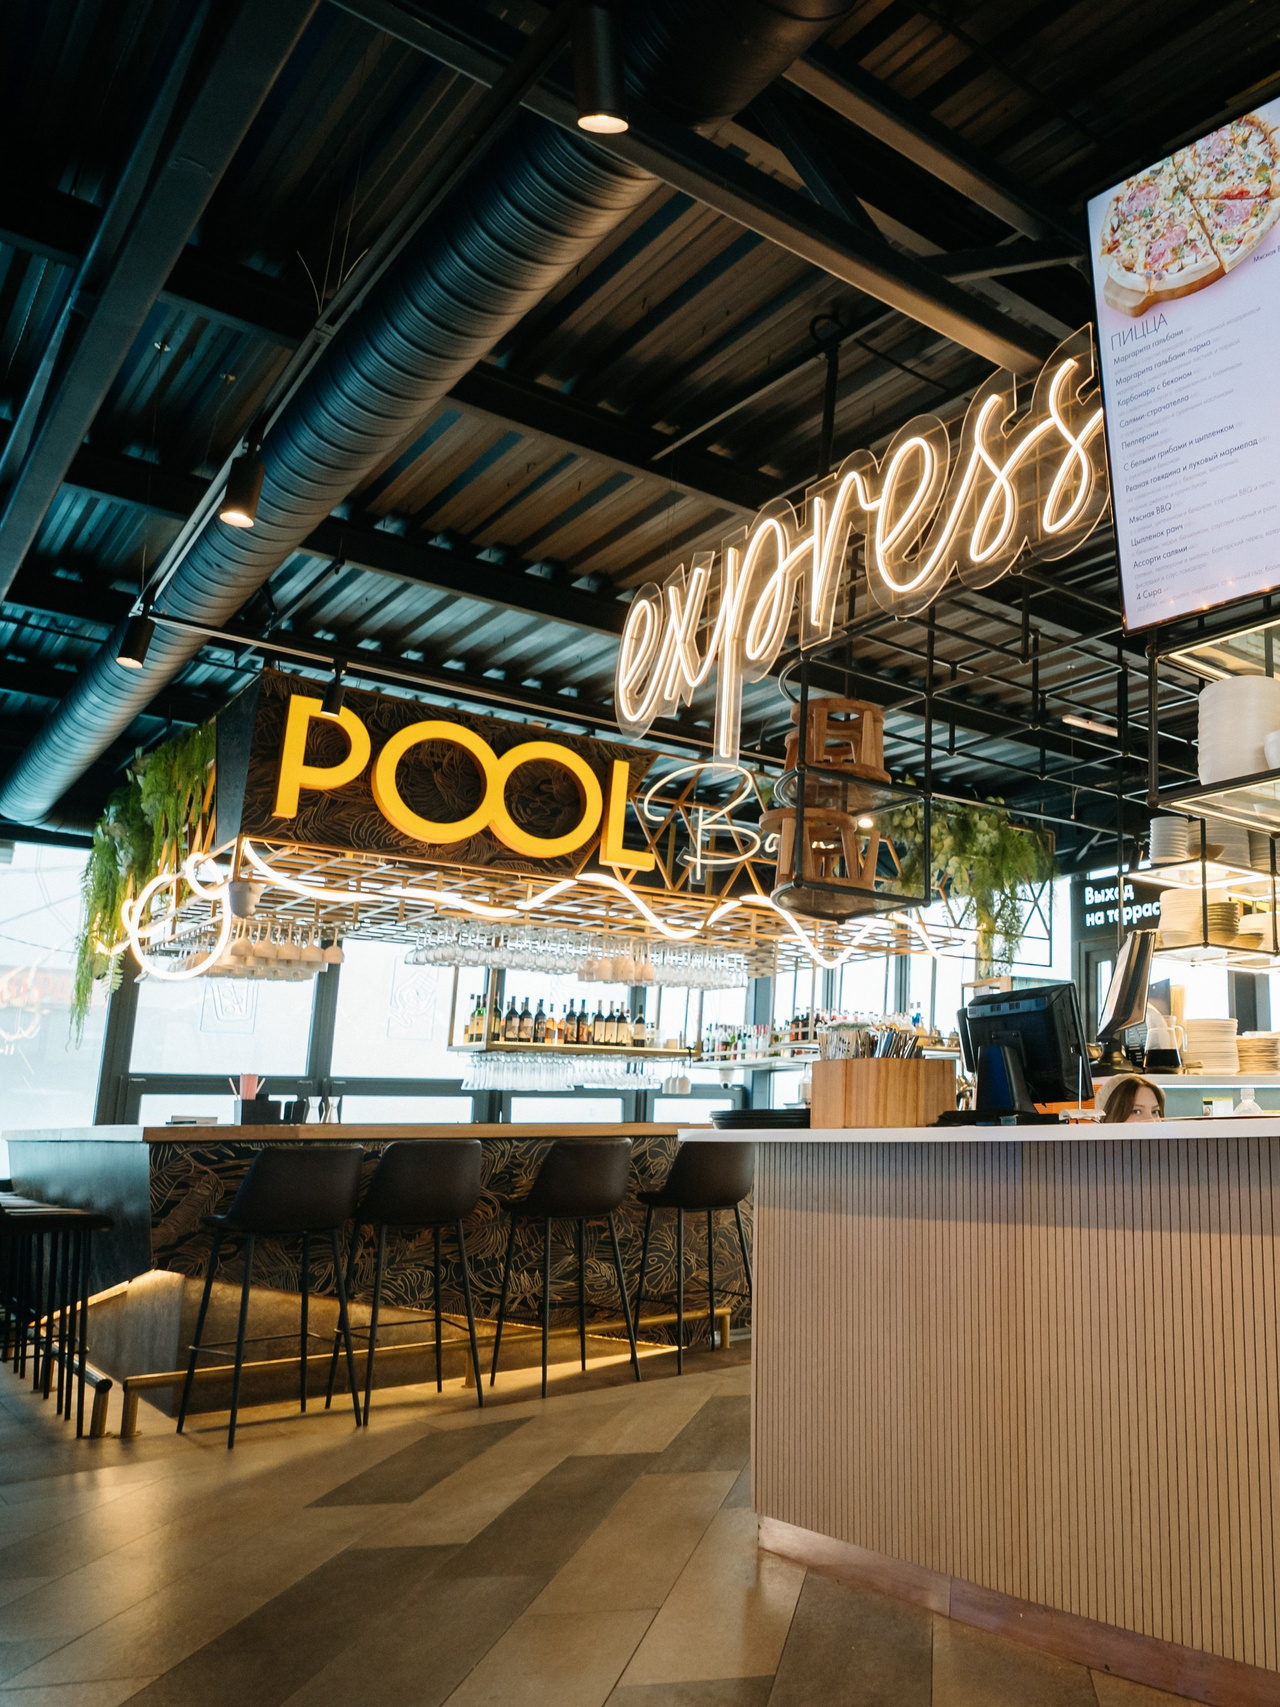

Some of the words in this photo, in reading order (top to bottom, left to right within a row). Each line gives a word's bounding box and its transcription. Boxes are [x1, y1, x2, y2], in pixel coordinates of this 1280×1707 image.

[1252, 249, 1276, 262] Мясная
[1110, 312, 1168, 351] ПИЦЦА
[1113, 343, 1151, 365] Маргарита
[1115, 365, 1153, 386] Маргарита
[1116, 386, 1156, 407] Карбонара
[1161, 370, 1192, 388] беконом
[1118, 394, 1189, 428] Салями-страчателла
[1121, 430, 1159, 450] Пепперони
[1122, 462, 1129, 471] С
[1129, 454, 1156, 469] белыми
[1156, 441, 1187, 459] грибами
[1194, 423, 1234, 444] цыпленком
[1125, 479, 1149, 493] Рваная
[1149, 467, 1181, 484] говядина
[1188, 451, 1218, 470] луковый
[1219, 438, 1258, 457] мармелад
[1128, 510, 1155, 524] Мясная
[1155, 501, 1172, 515] BBQ
[1130, 530, 1164, 547] Цыпленок
[1165, 524, 1183, 536] ранч
[618, 356, 1103, 758] express
[1132, 554, 1161, 568] Ассорти
[1162, 545, 1188, 559] салями
[1135, 592, 1141, 600] 4
[1142, 587, 1162, 599] Сыра
[273, 694, 655, 872] POOL
[1085, 884, 1134, 905] Выход
[1086, 911, 1105, 927] на
[1106, 902, 1161, 926] террас
